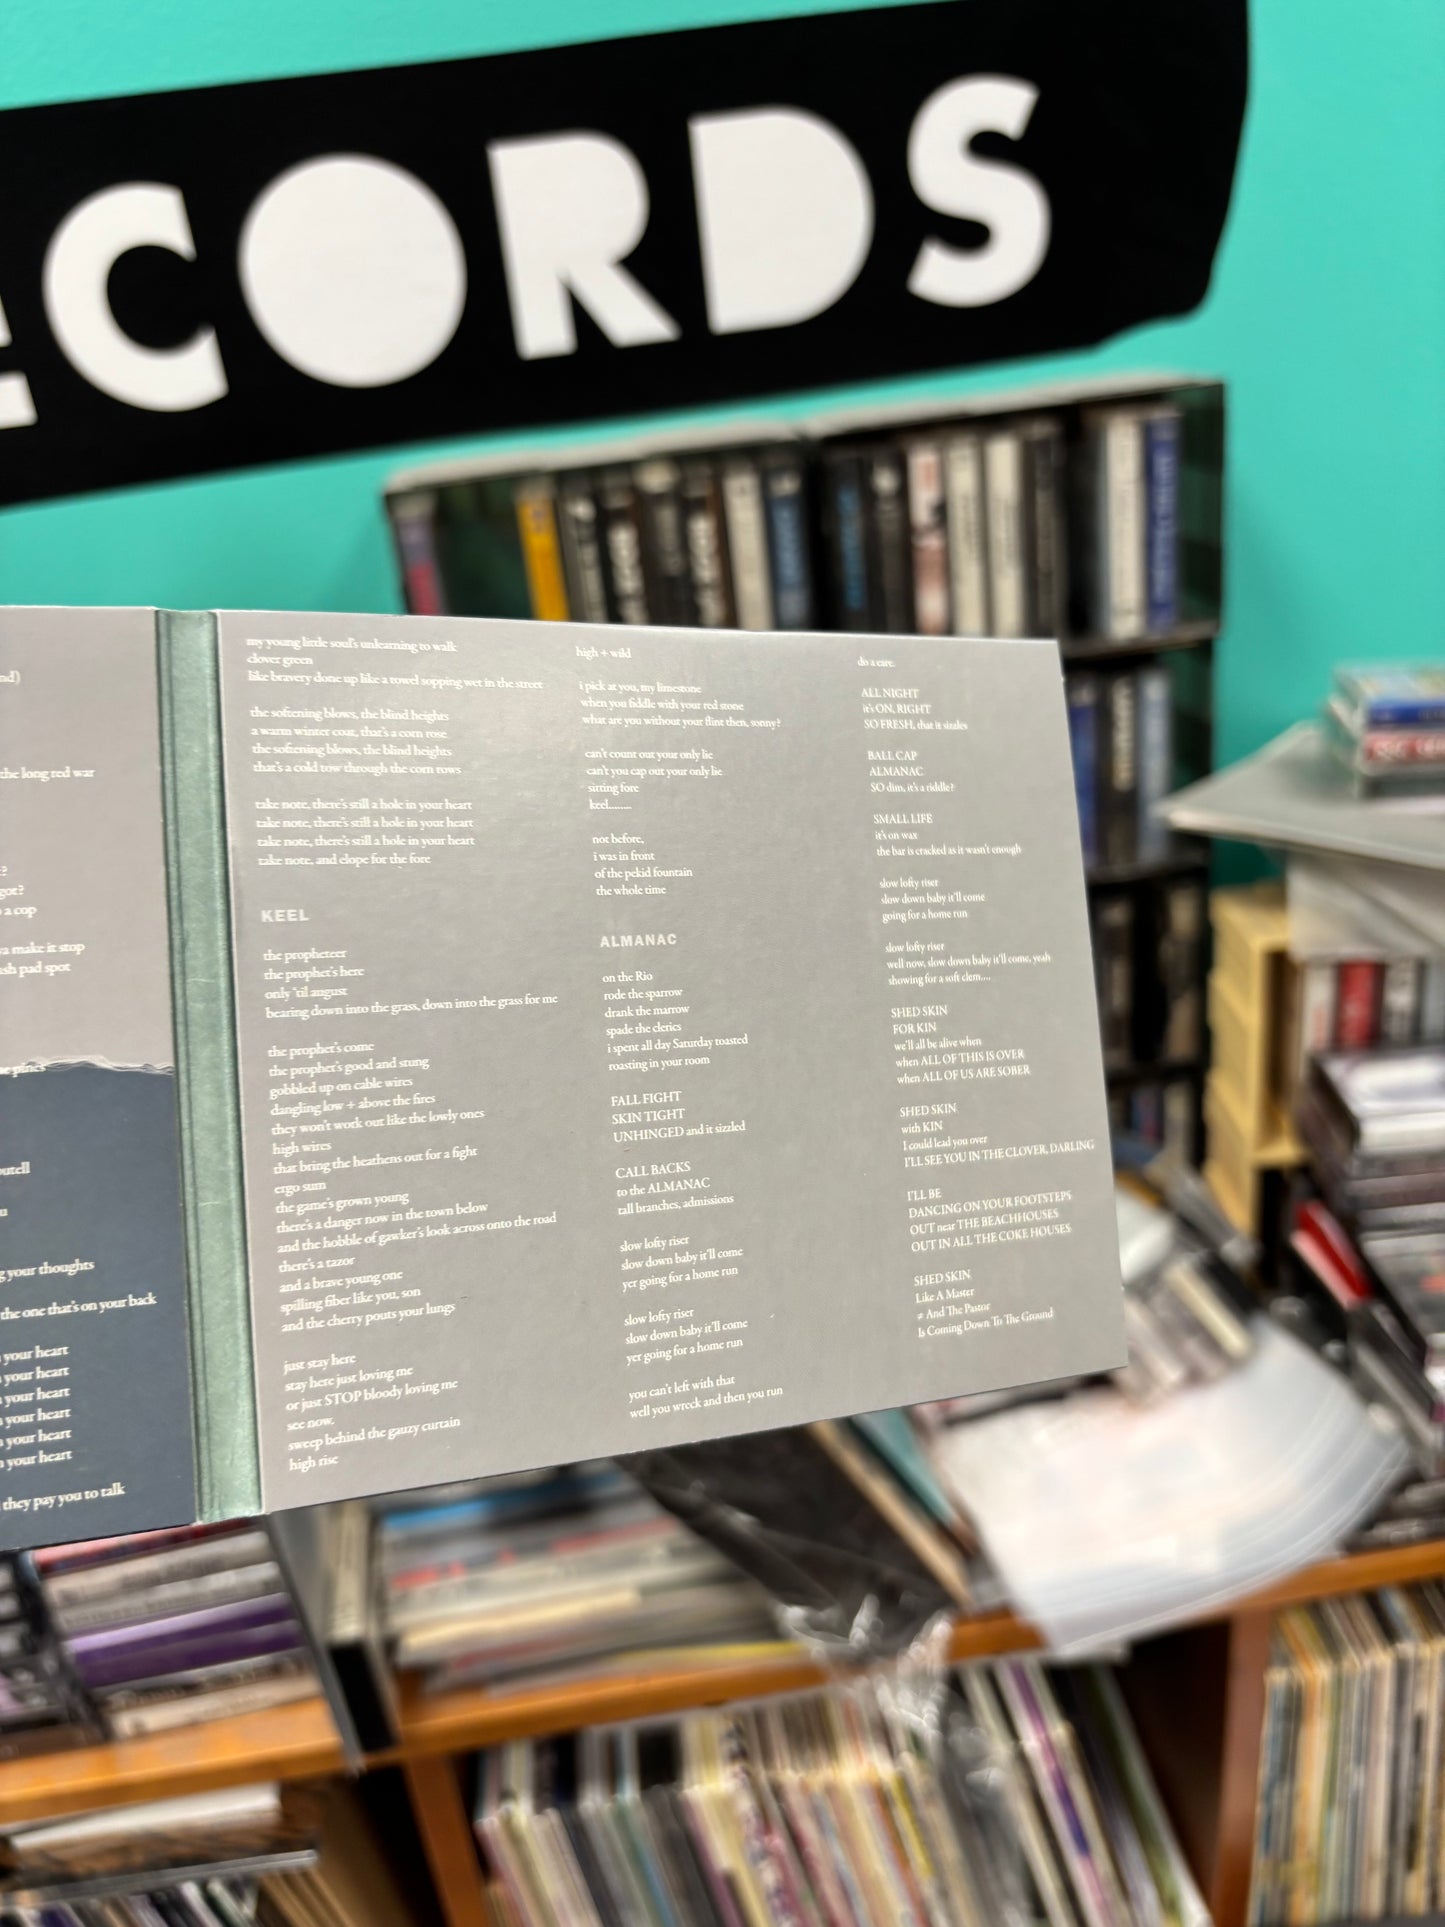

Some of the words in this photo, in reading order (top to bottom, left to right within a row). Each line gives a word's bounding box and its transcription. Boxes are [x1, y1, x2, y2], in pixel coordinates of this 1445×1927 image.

[21, 767, 50, 781] long
[50, 767, 71, 778] red
[73, 770, 95, 778] war
[595, 867, 606, 878] of
[607, 867, 623, 878] the
[653, 866, 693, 877] fountain
[596, 884, 612, 895] the
[614, 884, 643, 895] whole
[645, 885, 666, 894] time
[261, 909, 309, 922] KEEL
[11, 942, 45, 954] make
[47, 943, 57, 953] it
[58, 943, 85, 955] stop
[600, 934, 678, 947] ALMANAC
[263, 949, 283, 960] the
[19, 962, 43, 976] pad
[44, 963, 71, 975] spot
[264, 967, 284, 979] the
[339, 965, 365, 976] here
[602, 974, 616, 983] on
[618, 971, 634, 982] the
[636, 970, 654, 981] Rio
[604, 988, 626, 1000] rode
[628, 987, 644, 999] the
[645, 989, 683, 1001] sparrow
[605, 1005, 634, 1017] drank
[636, 1004, 651, 1016] the
[653, 1006, 690, 1015] marrow
[891, 1006, 921, 1017] SHED
[923, 1005, 948, 1016] SKIN
[893, 1023, 915, 1034] FOR
[917, 1022, 937, 1033] KIN
[609, 1058, 648, 1073] roasting
[649, 1058, 659, 1068] in
[661, 1058, 683, 1070] your
[685, 1056, 710, 1065] room
[898, 1071, 921, 1084] when
[922, 1072, 942, 1083] ALL
[944, 1071, 959, 1081] OF
[961, 1070, 974, 1080] US
[976, 1068, 996, 1079] ARE
[998, 1066, 1031, 1078] SOBER
[270, 1100, 322, 1117] dangling
[323, 1099, 344, 1111] low
[358, 1095, 391, 1108] above
[393, 1094, 411, 1106] the
[413, 1092, 436, 1104] fires
[611, 1094, 640, 1106] FALL
[643, 1091, 681, 1104] FIGHT
[612, 1112, 642, 1124] SKIN
[646, 1109, 685, 1122] TIGHT
[614, 1127, 685, 1142] UNHINGED
[686, 1124, 704, 1136] and
[706, 1124, 713, 1134] it
[715, 1120, 746, 1133] sizzled
[902, 1121, 921, 1134] with
[923, 1121, 943, 1133] KIN
[273, 1141, 300, 1157] high
[302, 1140, 332, 1152] wires
[615, 1166, 648, 1178] CALL
[651, 1162, 691, 1175] BACKS
[617, 1187, 628, 1196] to
[630, 1183, 645, 1195] the
[648, 1178, 711, 1194] ALMANAC
[909, 1202, 962, 1218] DANCING
[964, 1200, 981, 1212] ON
[983, 1197, 1013, 1210] YOUR
[1014, 1190, 1072, 1206] FOOTSTEPS
[910, 1222, 935, 1234] OUT
[937, 1221, 955, 1230] near
[958, 1217, 980, 1229] THE
[982, 1209, 1059, 1227] BEACHHOUSES
[620, 1238, 642, 1251] slow
[644, 1236, 667, 1251] lofty
[669, 1235, 690, 1246] riser
[7, 1269, 36, 1282] your
[38, 1260, 95, 1279] thoughts
[914, 1273, 944, 1286] SHED
[945, 1270, 971, 1282] SKIN
[279, 1279, 302, 1292] and
[313, 1274, 343, 1288] brave
[345, 1274, 381, 1288] young
[382, 1272, 403, 1281] one
[916, 1290, 934, 1303] Like
[946, 1286, 975, 1300] Master
[0, 1307, 22, 1320] the
[21, 1308, 46, 1318] one
[80, 1303, 98, 1312] on
[99, 1300, 128, 1313] your
[128, 1294, 157, 1308] back
[918, 1325, 926, 1337] Is
[927, 1320, 963, 1339] Coming
[964, 1316, 991, 1331] Down
[994, 1315, 1003, 1327] To
[1006, 1312, 1020, 1325] The
[1021, 1307, 1055, 1323] Ground
[3, 1350, 34, 1362] your
[33, 1345, 69, 1358] heart
[284, 1359, 305, 1373] just
[307, 1357, 329, 1371] stay
[331, 1352, 356, 1365] here
[286, 1402, 300, 1411] or
[301, 1397, 322, 1412] just
[325, 1392, 362, 1407] STOP
[364, 1385, 403, 1403] bloody
[405, 1380, 440, 1398] loving
[441, 1381, 459, 1390] me
[630, 1404, 650, 1418] well
[652, 1404, 670, 1417] you
[673, 1396, 702, 1411] wreck
[704, 1394, 722, 1407] and
[724, 1390, 745, 1404] then
[747, 1390, 765, 1403] you
[767, 1388, 784, 1398] run
[288, 1438, 324, 1454] sweep
[325, 1429, 366, 1446] behind
[367, 1426, 387, 1440] the
[421, 1417, 461, 1432] curtain
[289, 1456, 316, 1473] high
[318, 1454, 339, 1466] rise
[2, 1495, 32, 1512] they
[32, 1496, 57, 1509] pay
[57, 1493, 83, 1506] you
[84, 1490, 100, 1500] to
[100, 1485, 125, 1499] talk
